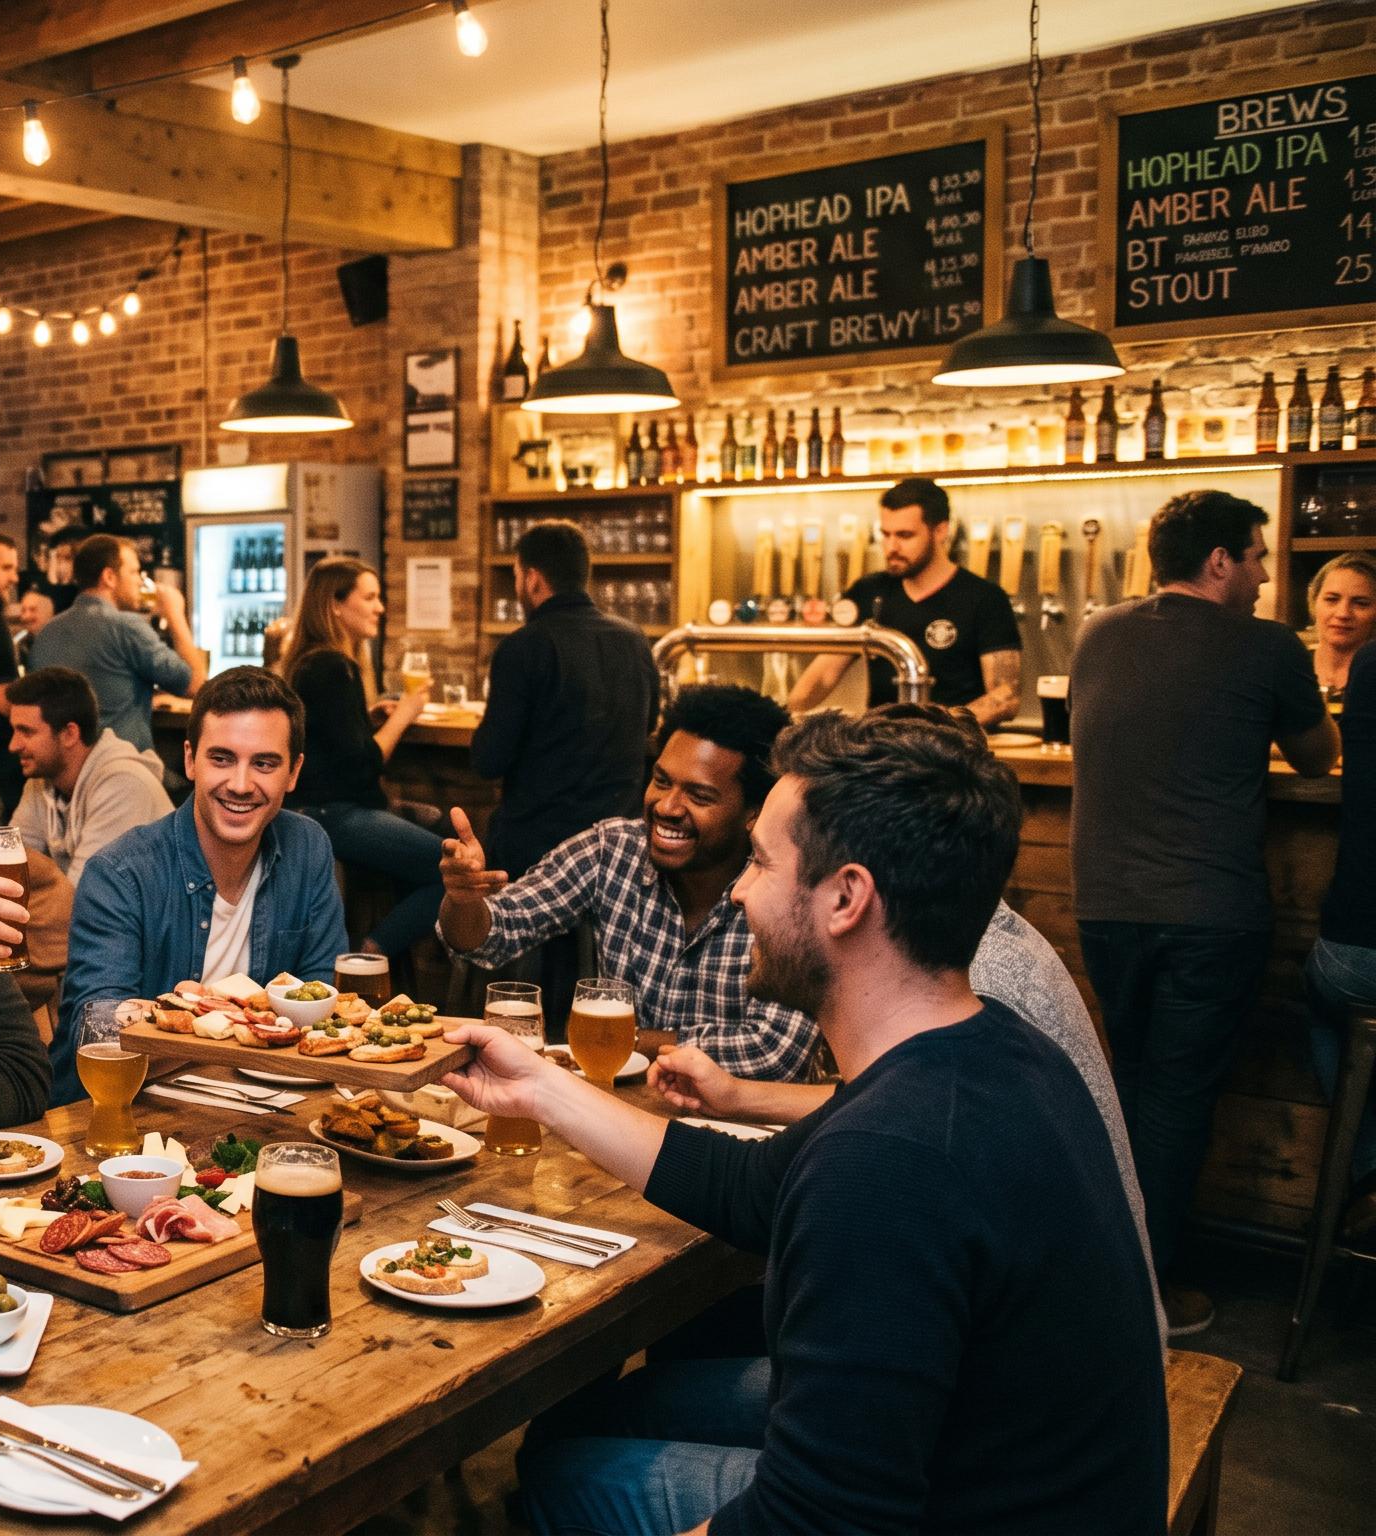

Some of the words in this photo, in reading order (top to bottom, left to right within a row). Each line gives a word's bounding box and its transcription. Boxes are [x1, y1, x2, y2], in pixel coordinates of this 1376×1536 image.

[1217, 86, 1348, 134] BREWS
[1127, 143, 1262, 190] HOPHEAD
[1276, 132, 1328, 170] IPA
[735, 194, 852, 238] HOPHEAD
[865, 183, 911, 218] IPA
[1127, 188, 1231, 231] AMBER
[1245, 177, 1307, 216] ALE
[1340, 212, 1373, 241] 14
[734, 238, 819, 276] AMBER
[828, 228, 880, 263] ALE
[1127, 236, 1169, 272] BT
[1335, 253, 1372, 286] 25
[734, 277, 818, 315] AMBER
[828, 268, 878, 302] ALE
[1128, 267, 1238, 309] STOUT
[734, 320, 819, 357] CRAFT
[829, 309, 920, 347] BREWY
